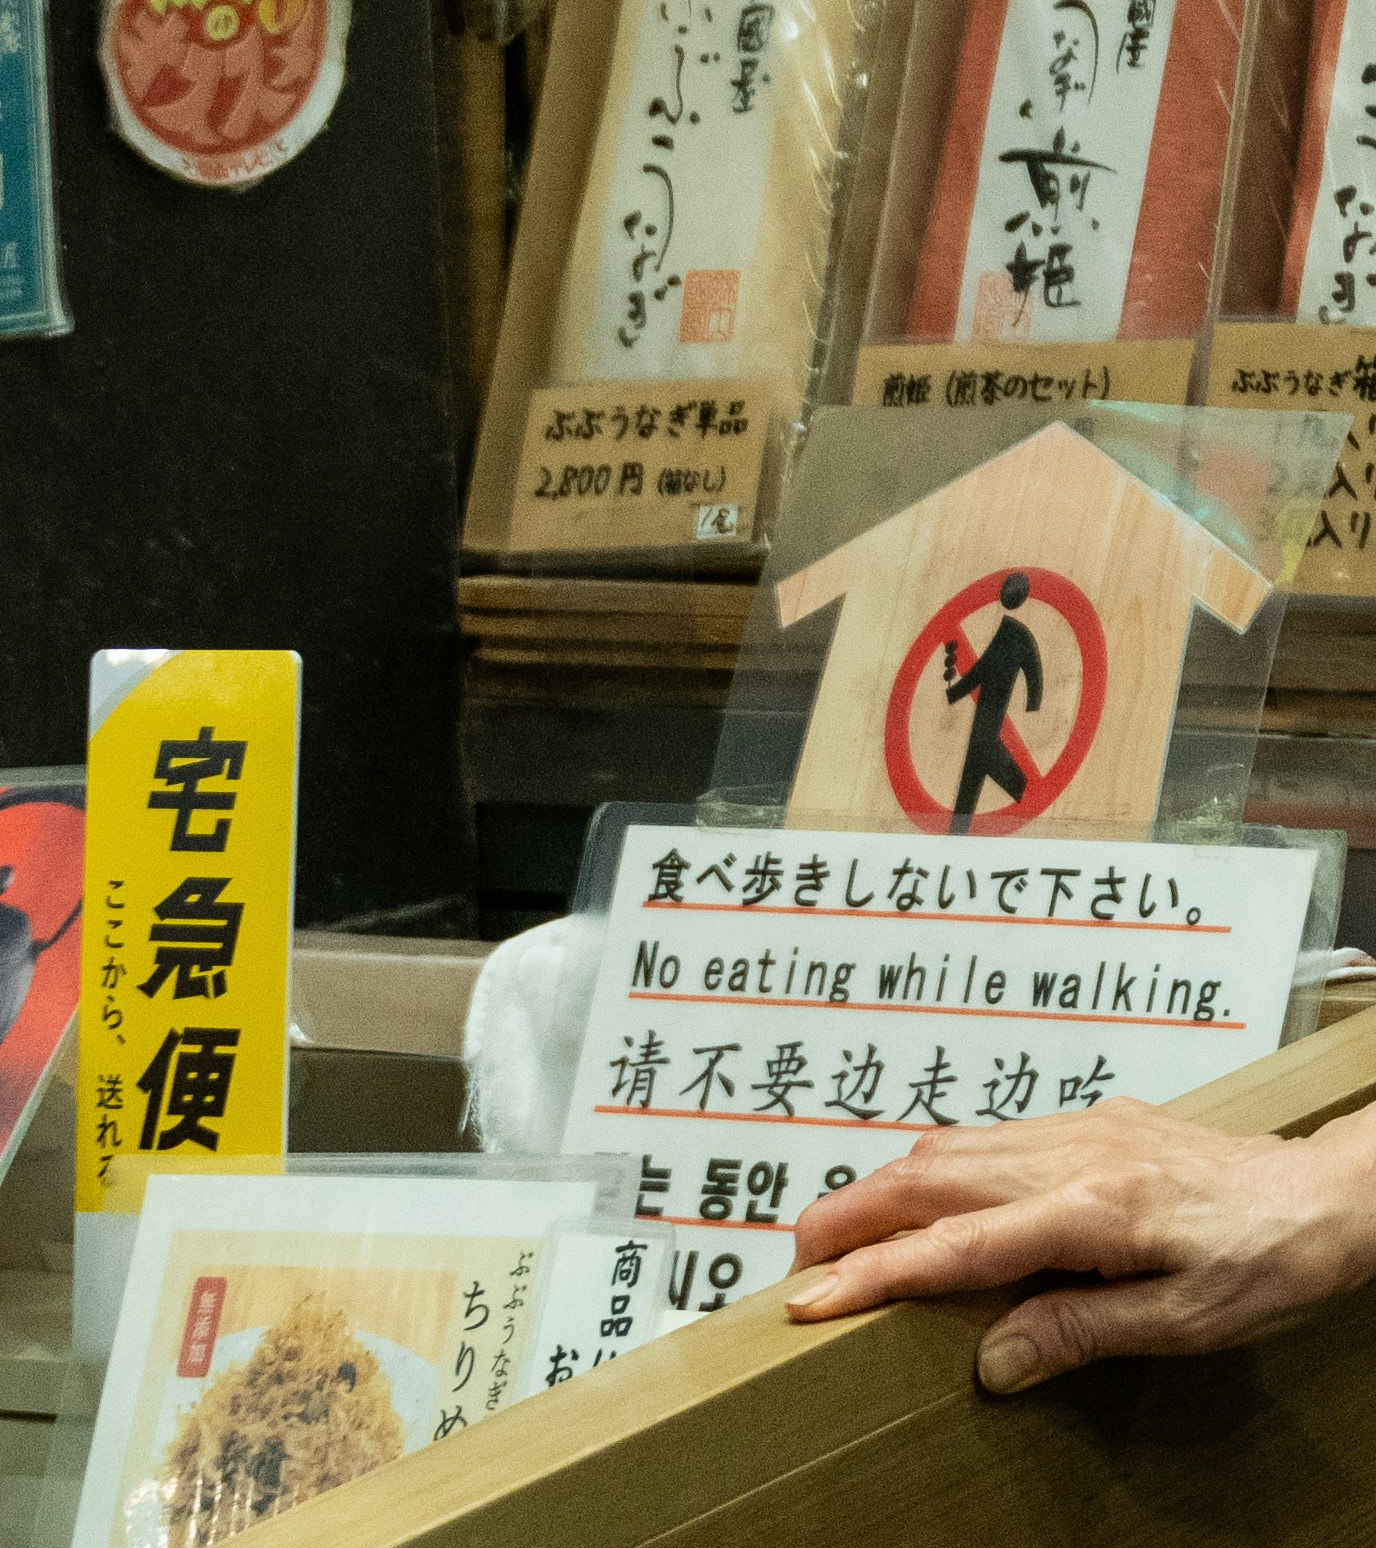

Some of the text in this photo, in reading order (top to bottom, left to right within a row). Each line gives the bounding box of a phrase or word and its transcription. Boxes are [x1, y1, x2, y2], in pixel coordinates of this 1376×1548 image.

[534, 461, 645, 499] 2,800円
[648, 847, 1204, 925] 食べ歩きしないで下さい。
[136, 726, 248, 1152] 宅急便
[631, 941, 1233, 1022] No eating while walking.
[610, 1030, 1114, 1126] 请不要边走边吃
[699, 1158, 788, 1223] 동안
[485, 1251, 533, 1410] ぶぶうなぎ
